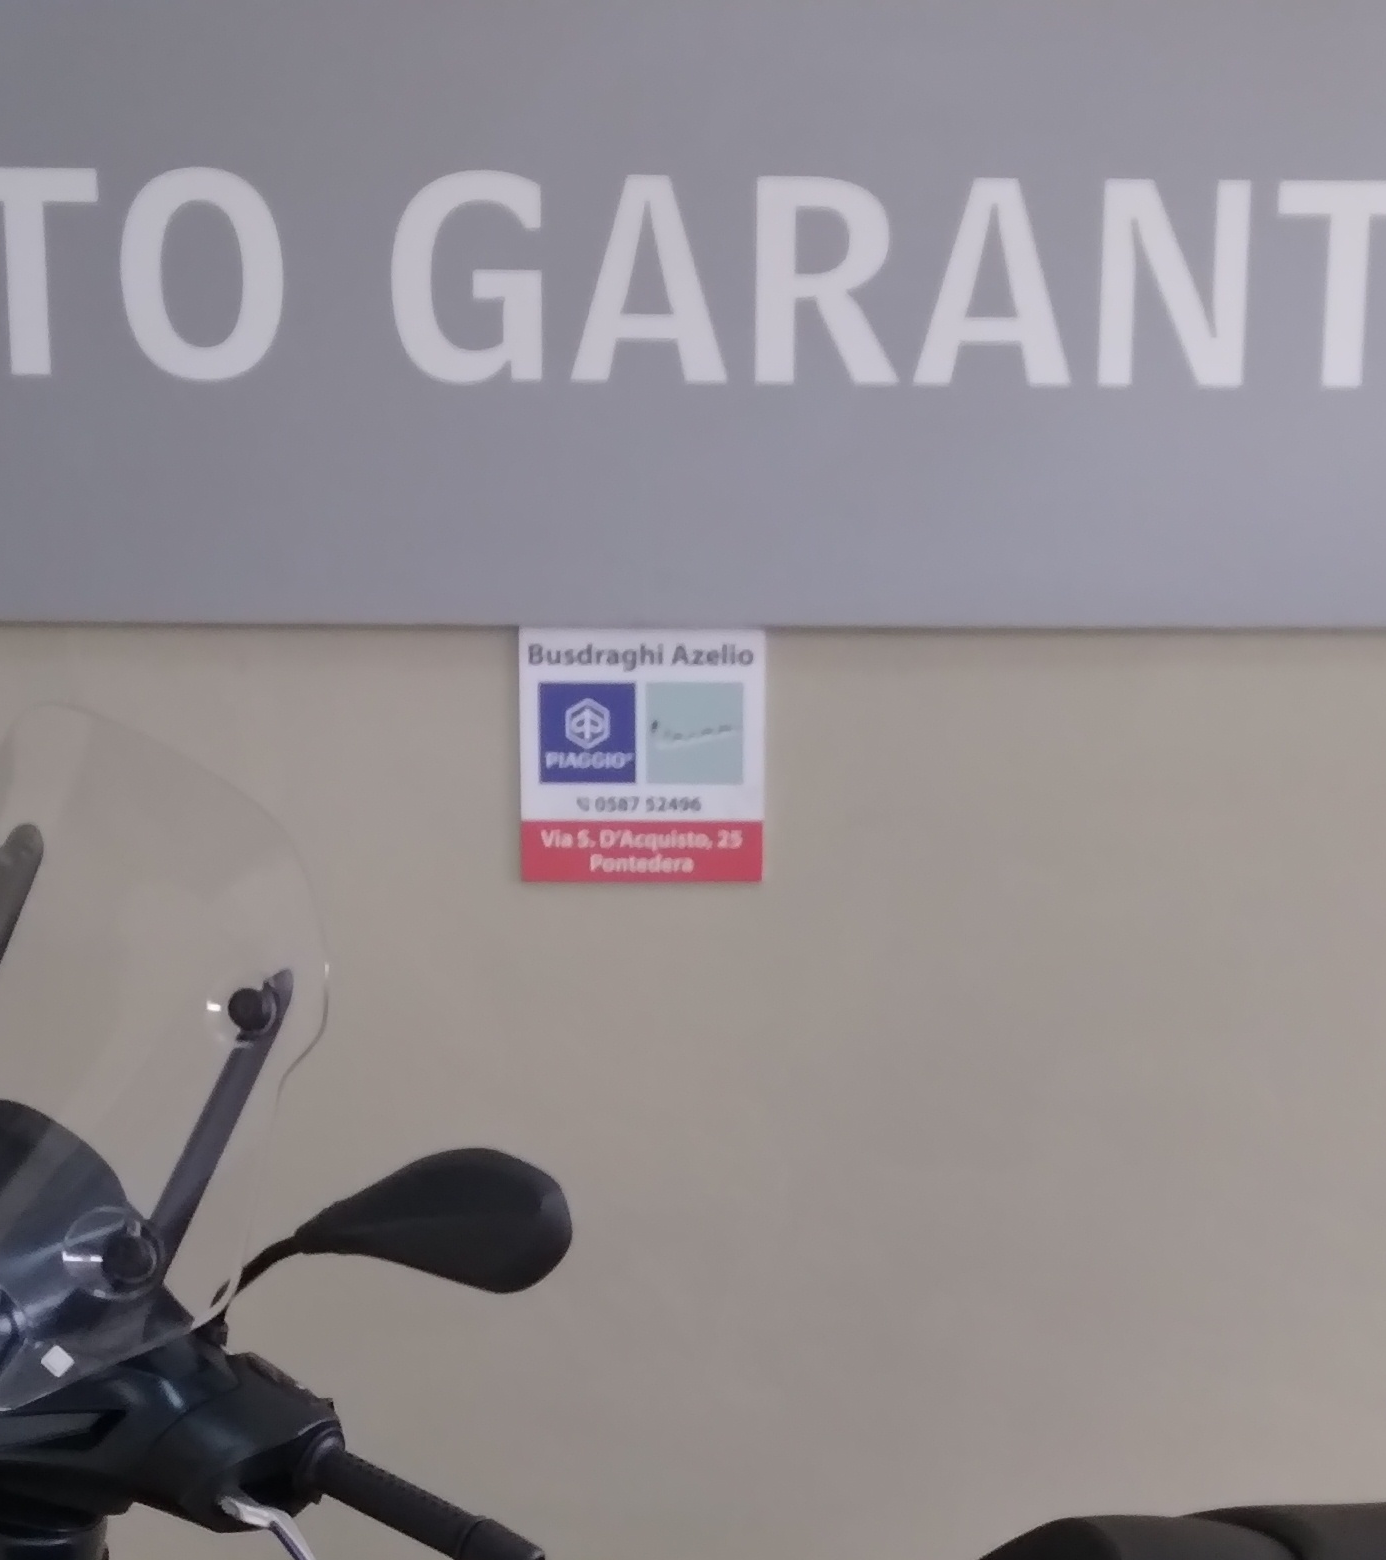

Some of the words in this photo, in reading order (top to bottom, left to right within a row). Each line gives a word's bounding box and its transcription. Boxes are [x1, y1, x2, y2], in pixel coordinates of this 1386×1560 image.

[527, 643, 664, 672] Busdraghi
[671, 644, 754, 666] Azelio
[545, 751, 627, 769] PIAGGIO
[594, 796, 640, 812] 0587
[540, 829, 573, 848] Via
[577, 829, 596, 848] S.
[589, 853, 695, 873] Pontedera
